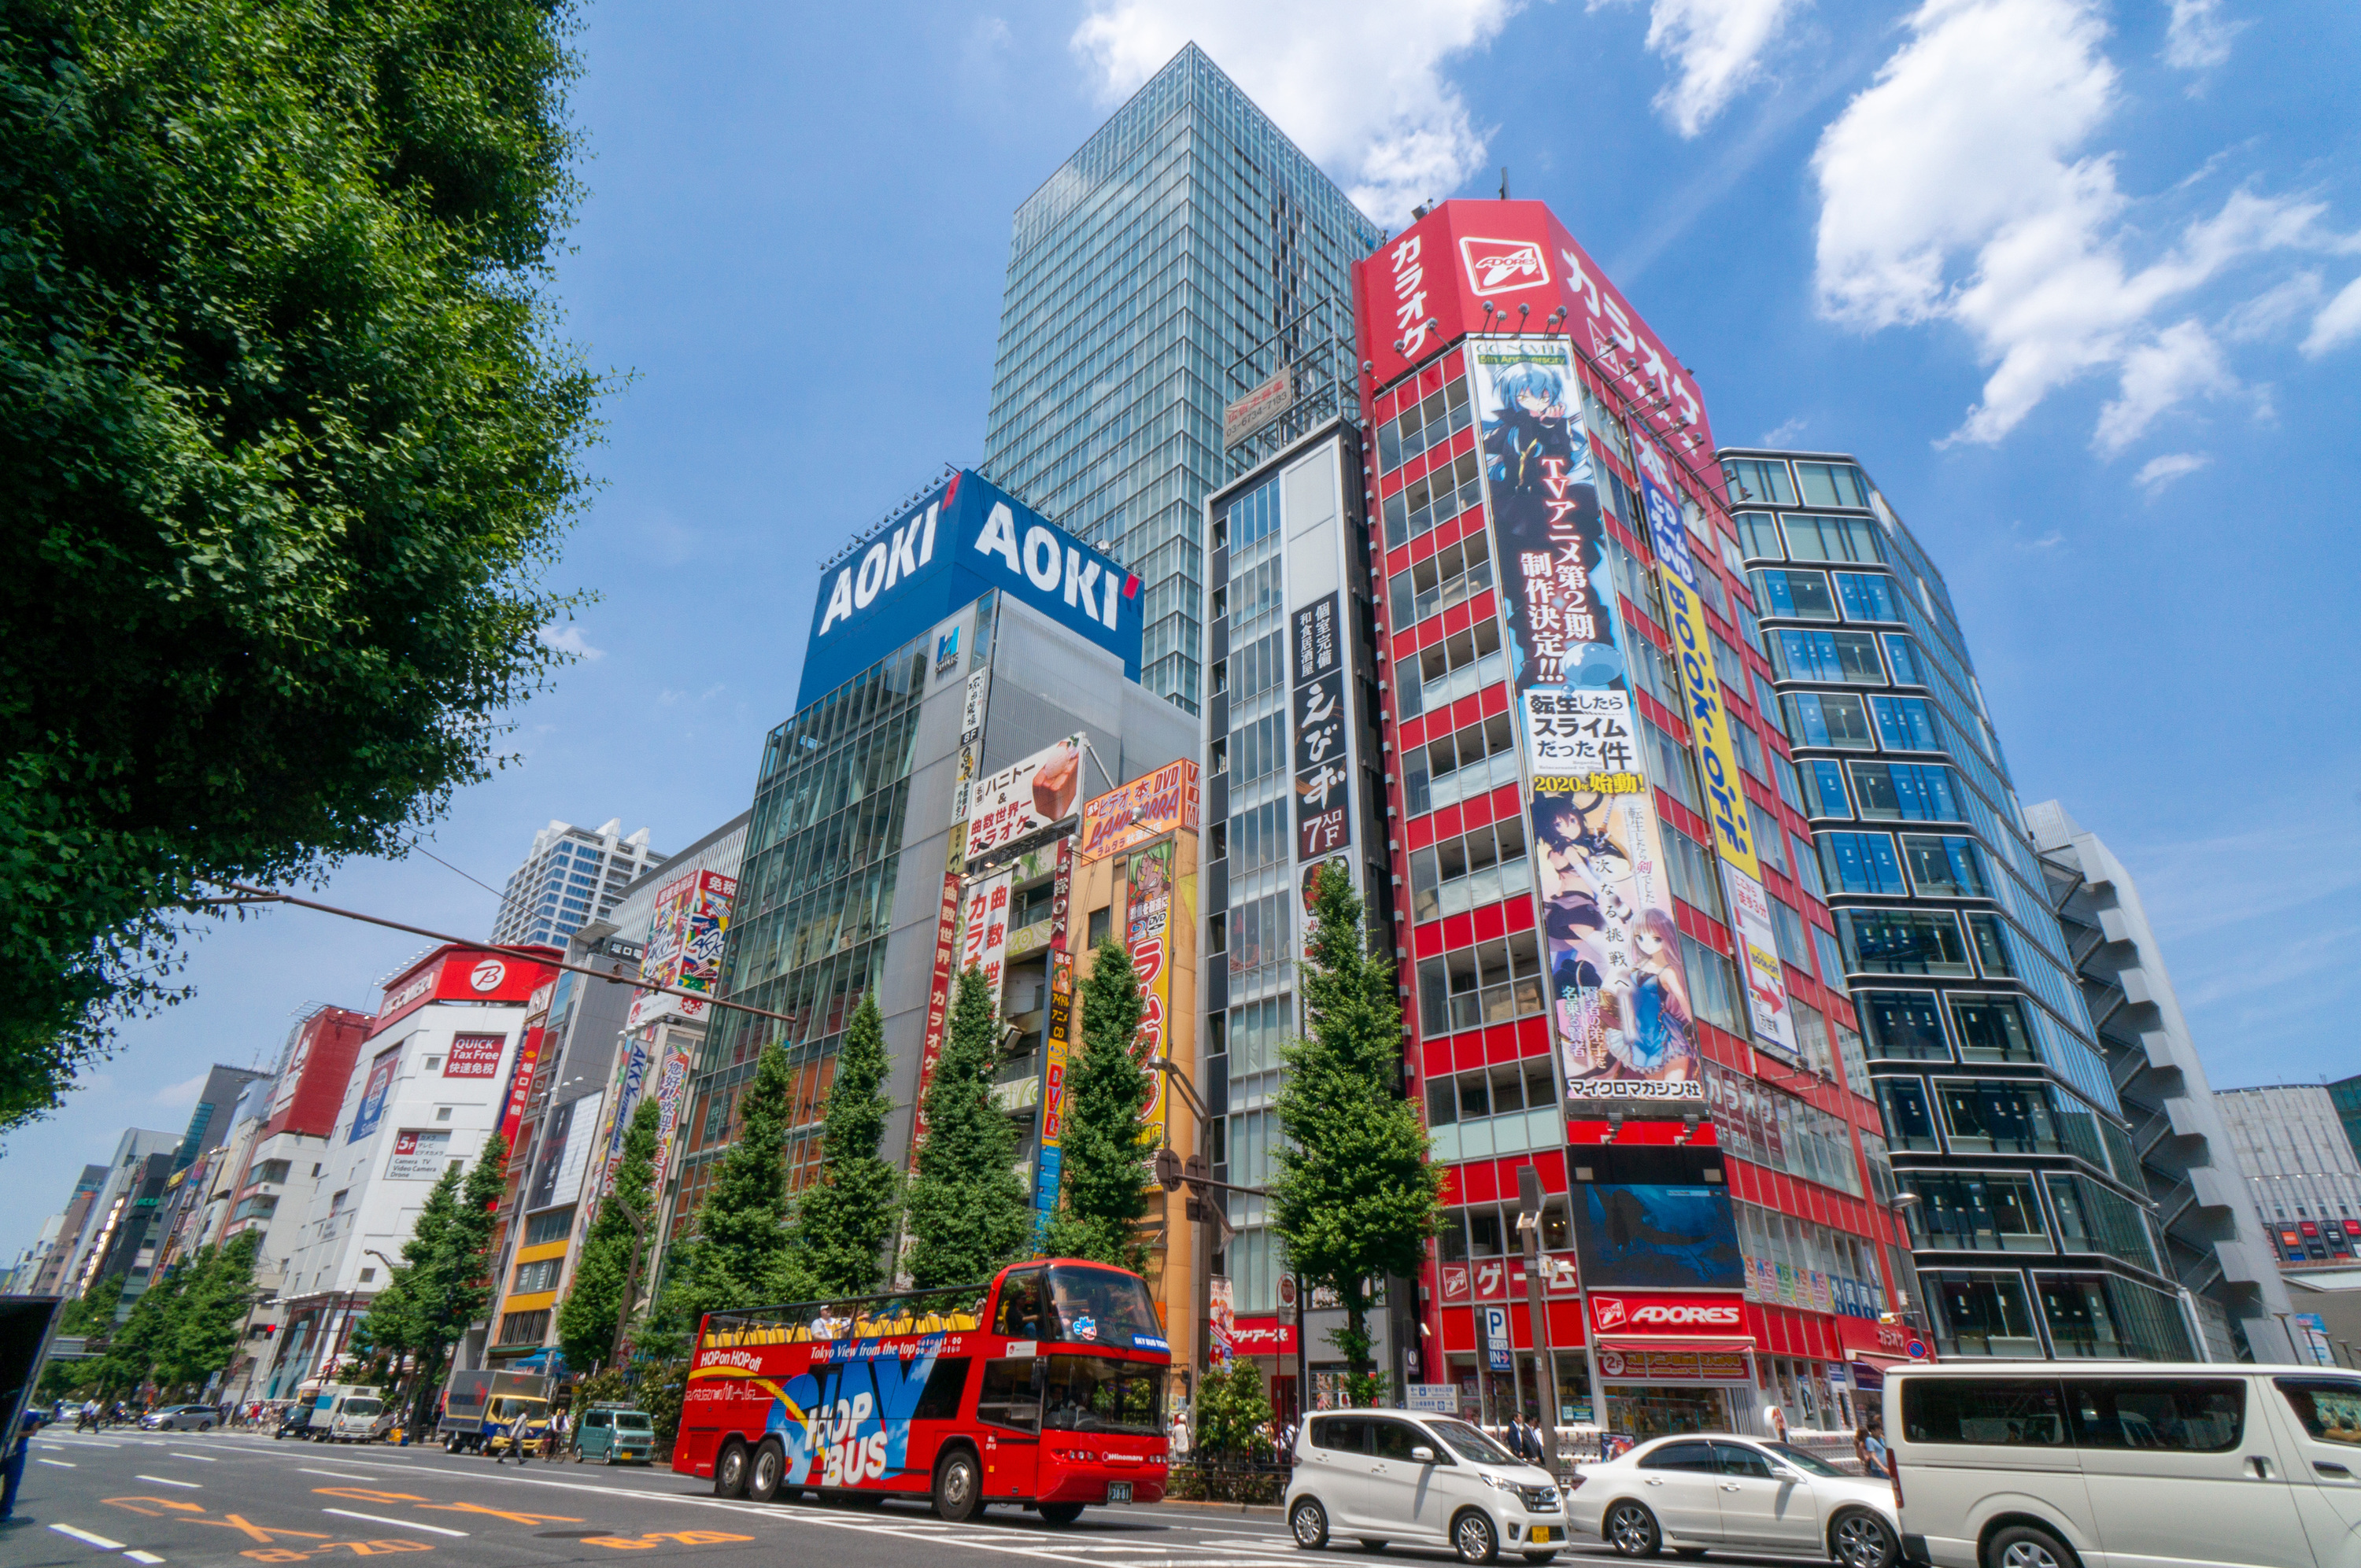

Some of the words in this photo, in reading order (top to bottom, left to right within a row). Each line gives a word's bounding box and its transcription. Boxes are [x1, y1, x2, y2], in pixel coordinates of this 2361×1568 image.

[1391, 235, 1427, 358] カラオケ
[1561, 248, 1700, 425] カラオケ
[1476, 345, 1496, 354] GC
[1506, 345, 1565, 355] NOVELS
[1480, 355, 1498, 364] 5th
[1500, 355, 1565, 365] Anniversary
[1635, 433, 1674, 495] 本
[1542, 459, 1595, 640] TVアニメ第2期
[1657, 534, 1694, 584] DVD
[818, 500, 940, 636] AOKI
[974, 500, 1119, 632] AOKI
[1299, 612, 1314, 678] 和食居酒屋
[1314, 600, 1332, 670] 個室完備
[1530, 695, 1623, 715] 転生したら
[963, 729, 977, 744] 8F
[1534, 718, 1628, 738] スライム
[1538, 740, 1631, 770] だった件
[985, 764, 1036, 796] ハニトー
[1535, 772, 1646, 794] 2020年始動!
[998, 792, 1007, 805] &
[971, 799, 1032, 836] 曲数世界一
[968, 815, 1030, 856] カラオケ
[1126, 821, 1162, 845] 秋葉原店
[1097, 837, 1125, 857] ラムタラ
[1628, 806, 1656, 904] 転生したら剣でした
[1735, 874, 1757, 898] ここから
[1148, 911, 1166, 925] DVD
[1596, 859, 1630, 988] 次なる挑戦へ
[1051, 992, 1070, 1007] アイドル
[1051, 1009, 1069, 1023] アニメ
[1562, 985, 1586, 1057] 名乗る賢者
[1583, 986, 1607, 1069] 賢者の弟子を
[1053, 1025, 1064, 1039] CD
[453, 1050, 472, 1060] Tax
[474, 1050, 499, 1060] Free
[456, 1039, 494, 1050] QUICK
[449, 1062, 494, 1074] 快速免税
[627, 1043, 647, 1098] AKKY
[509, 1062, 534, 1116] 坂口電熱
[1569, 1080, 1701, 1097] マイクロマガジン社
[1044, 1063, 1065, 1140] DVD
[397, 1136, 416, 1151] 5F
[1490, 1312, 1502, 1335] P
[1631, 1306, 1740, 1323] ADORES
[811, 1346, 834, 1363] Tokyo
[837, 1344, 858, 1359] View
[859, 1342, 882, 1356] from
[882, 1341, 899, 1355] the
[900, 1343, 916, 1358] top
[1134, 1337, 1146, 1346] SKY
[1146, 1338, 1155, 1347] BUS
[700, 1350, 719, 1367] HOP
[719, 1352, 730, 1364] on
[730, 1351, 749, 1367] HOP
[749, 1356, 763, 1372] off
[1490, 1351, 1501, 1363] IN
[1606, 1356, 1623, 1369] 2F
[805, 1392, 873, 1452] HOP
[822, 1431, 888, 1487] BUS
